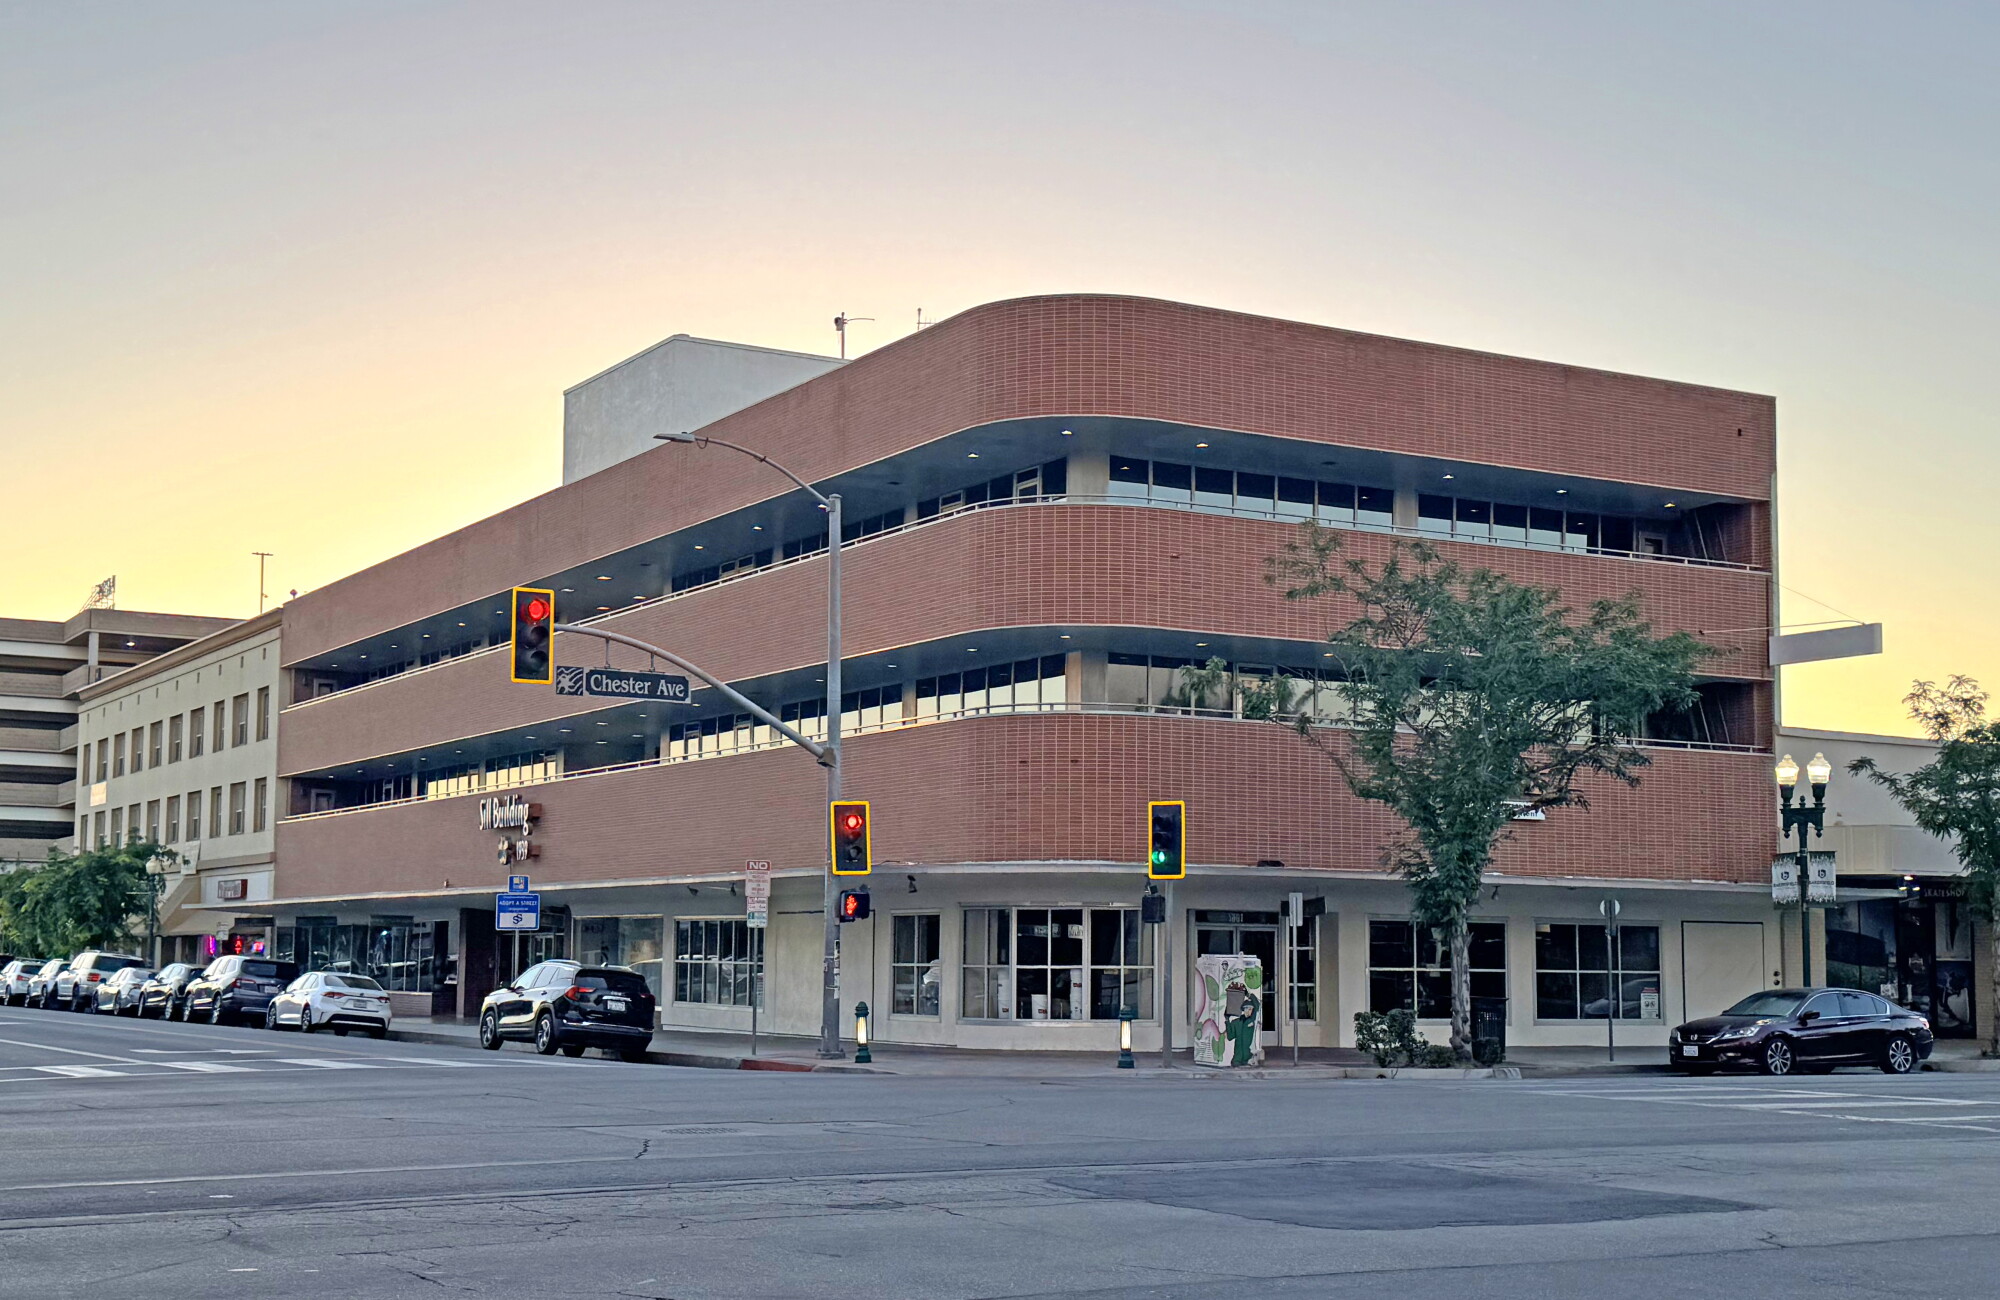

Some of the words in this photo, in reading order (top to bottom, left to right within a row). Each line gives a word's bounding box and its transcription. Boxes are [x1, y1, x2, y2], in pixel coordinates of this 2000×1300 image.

[590, 674, 652, 695] Chester
[656, 679, 685, 698] Ave
[479, 797, 492, 831] Sill
[492, 793, 530, 836] Building
[748, 861, 768, 870] NO
